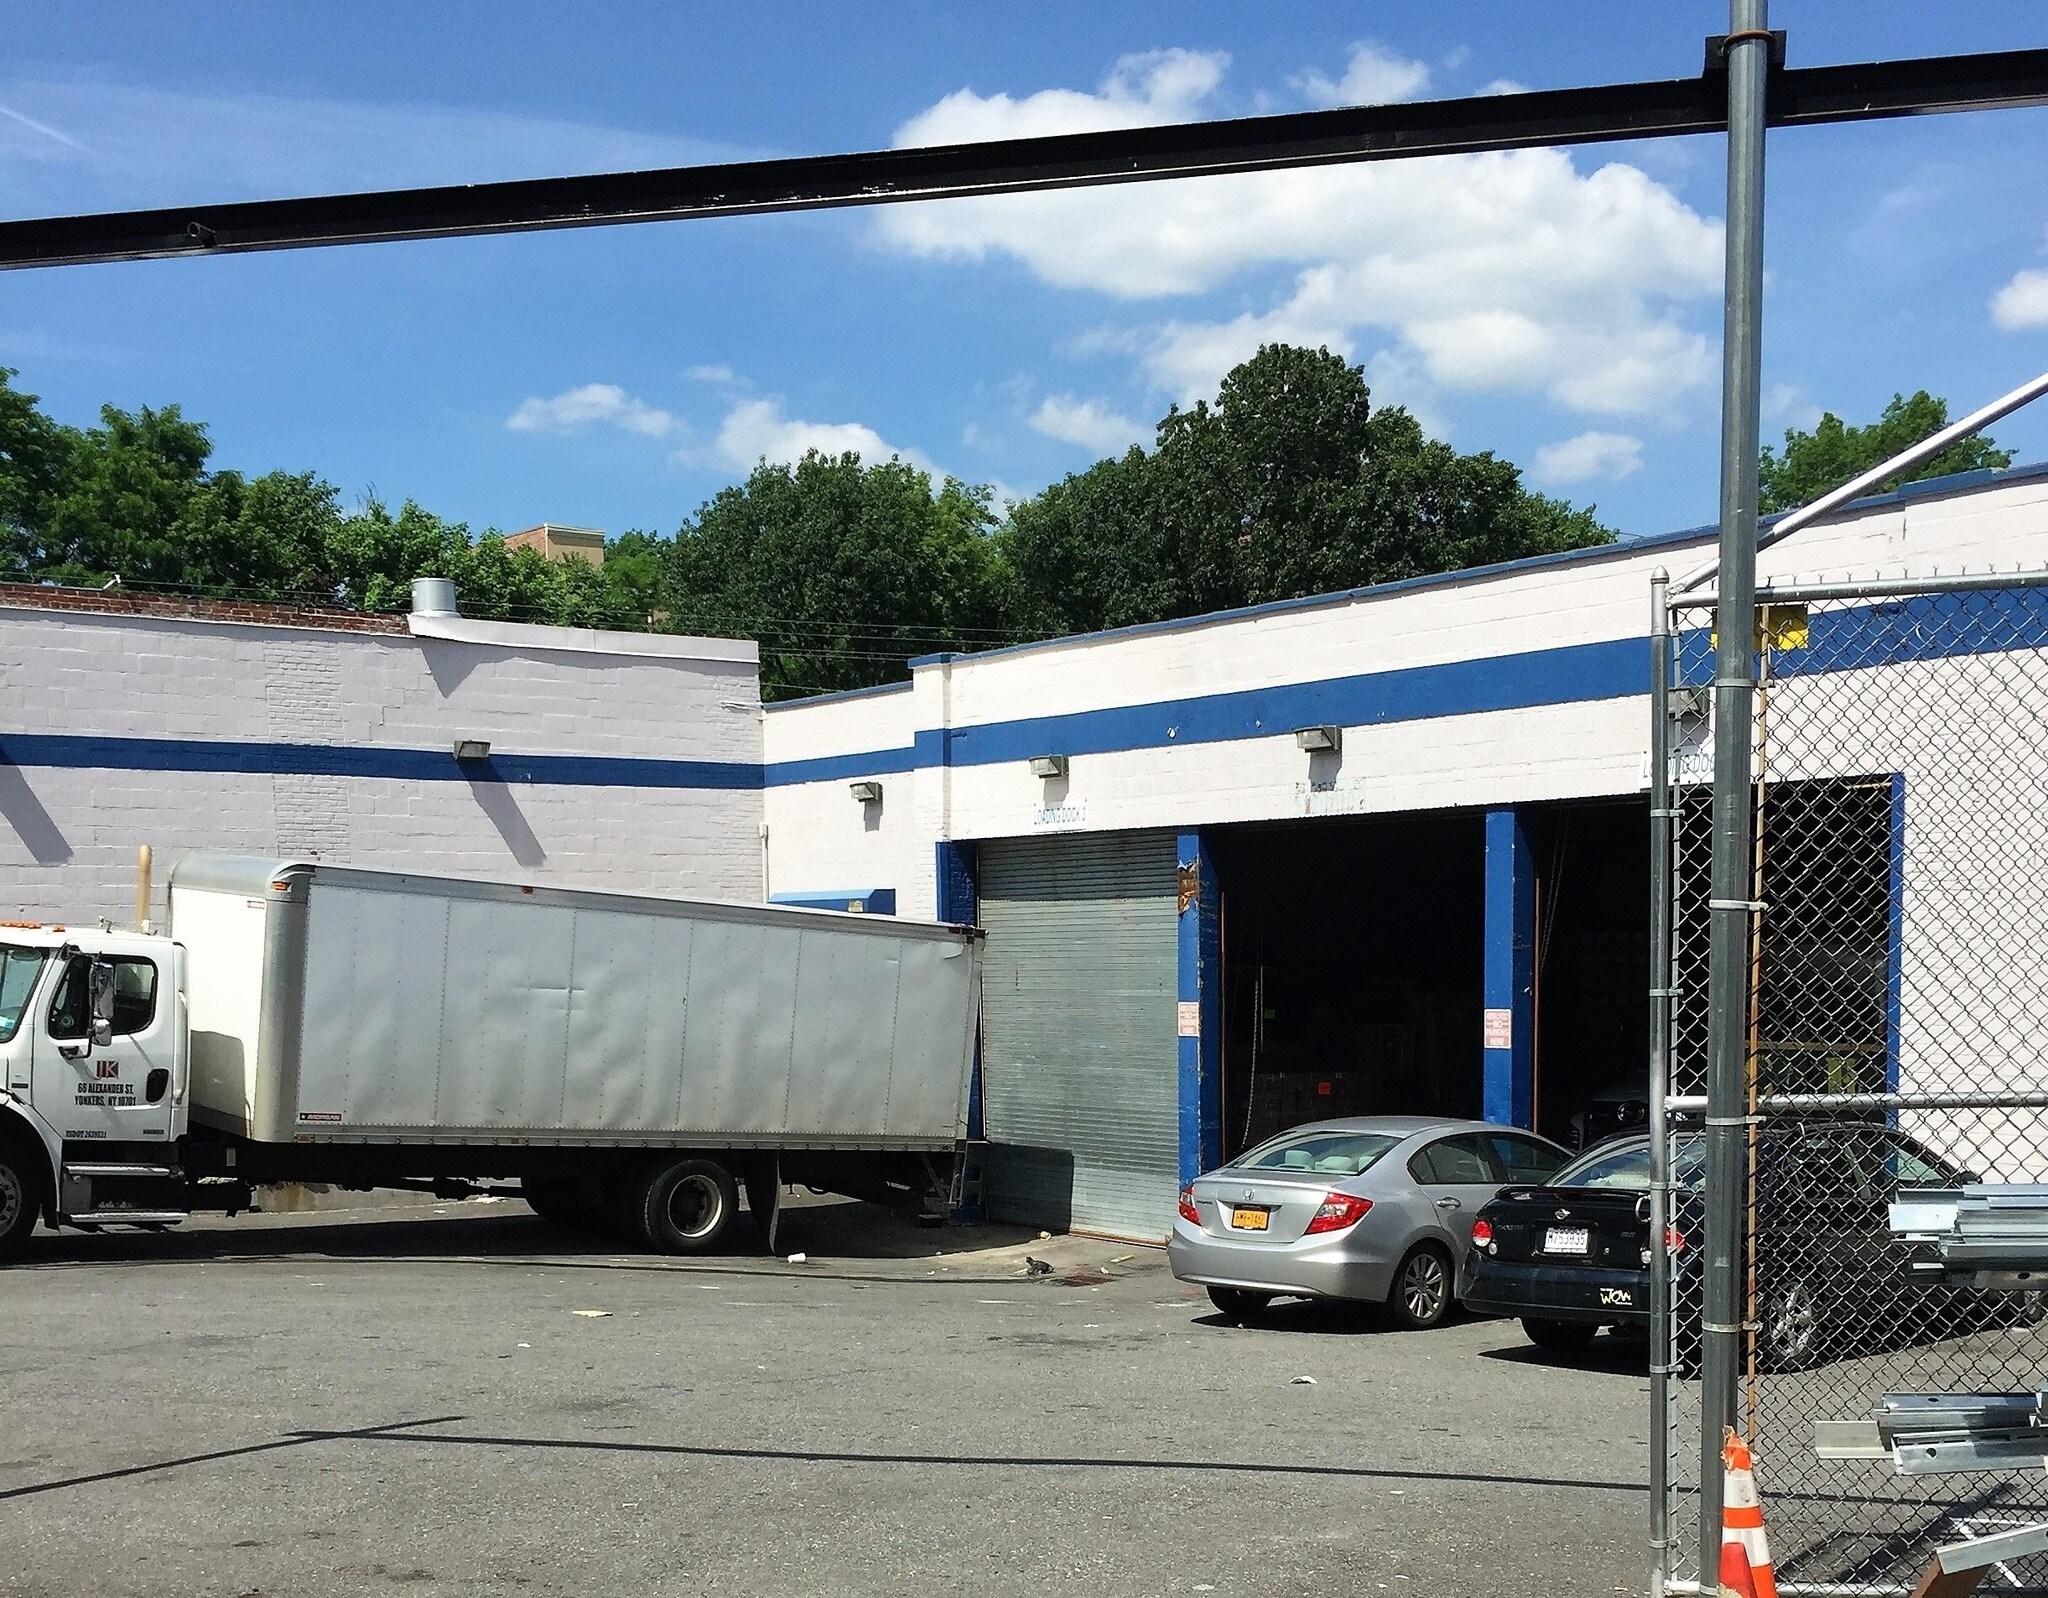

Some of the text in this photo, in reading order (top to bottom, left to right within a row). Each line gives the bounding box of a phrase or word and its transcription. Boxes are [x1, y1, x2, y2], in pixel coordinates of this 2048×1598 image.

[88, 1083, 124, 1094] ALEXANDER
[108, 1096, 117, 1107] NY
[118, 1096, 137, 1107] 10701
